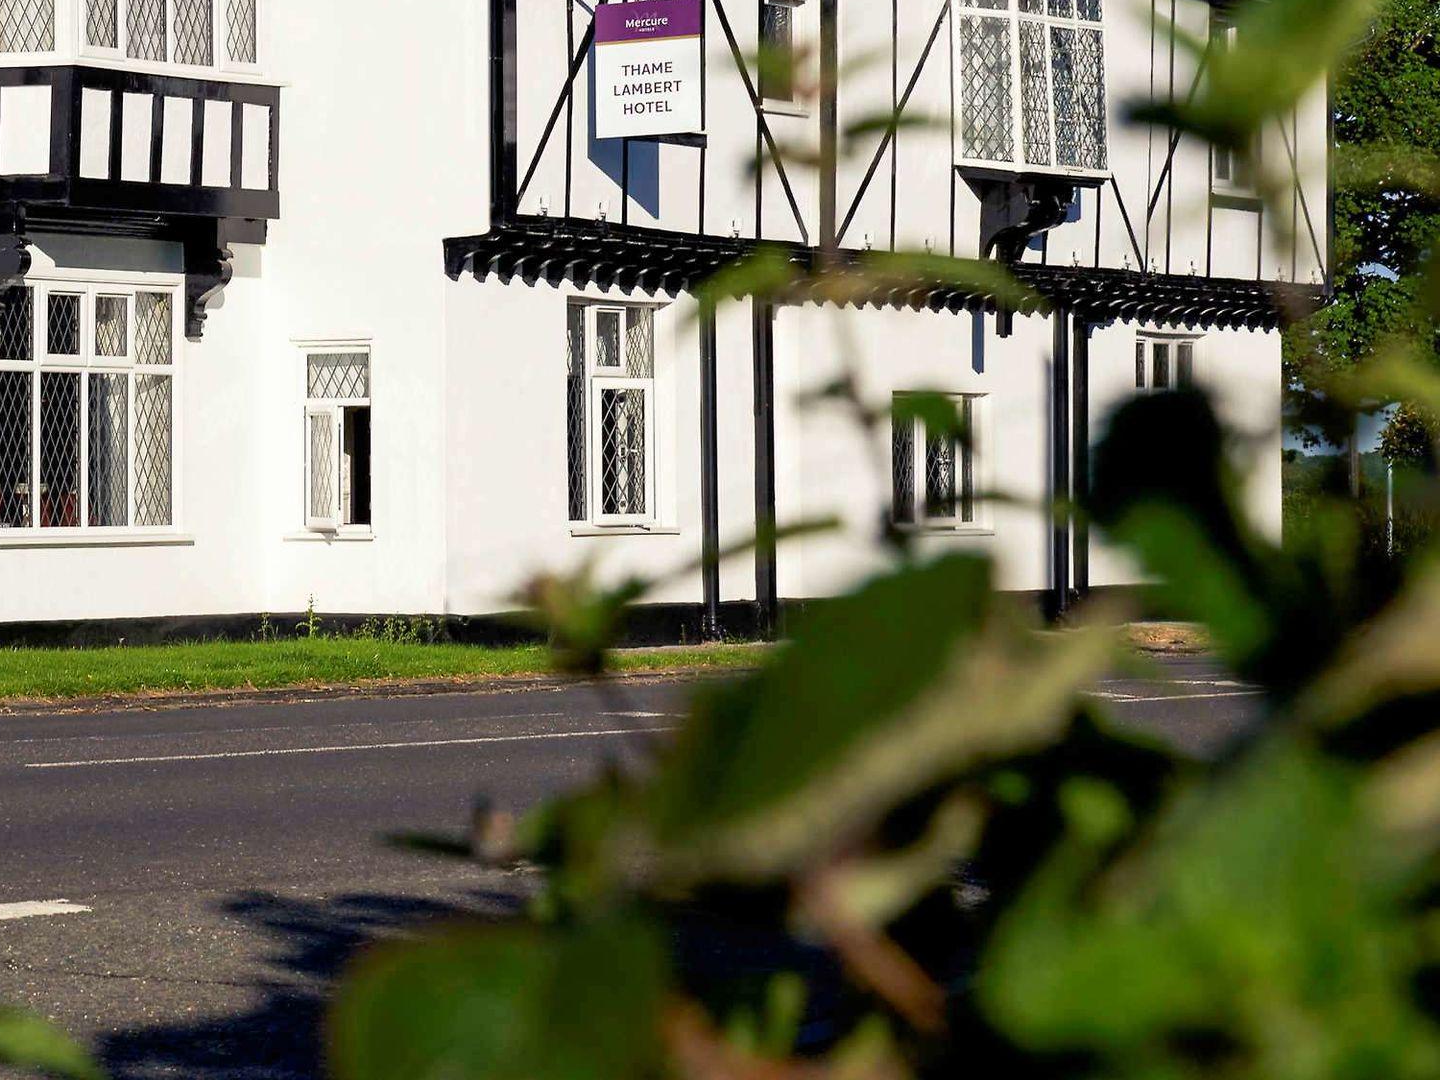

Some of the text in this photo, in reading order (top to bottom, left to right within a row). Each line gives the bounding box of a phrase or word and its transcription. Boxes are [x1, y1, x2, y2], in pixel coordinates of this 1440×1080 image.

[625, 17, 668, 28] Mercure
[621, 61, 673, 77] THAME
[613, 80, 682, 97] LAMBERT
[623, 100, 672, 115] HOTEL
